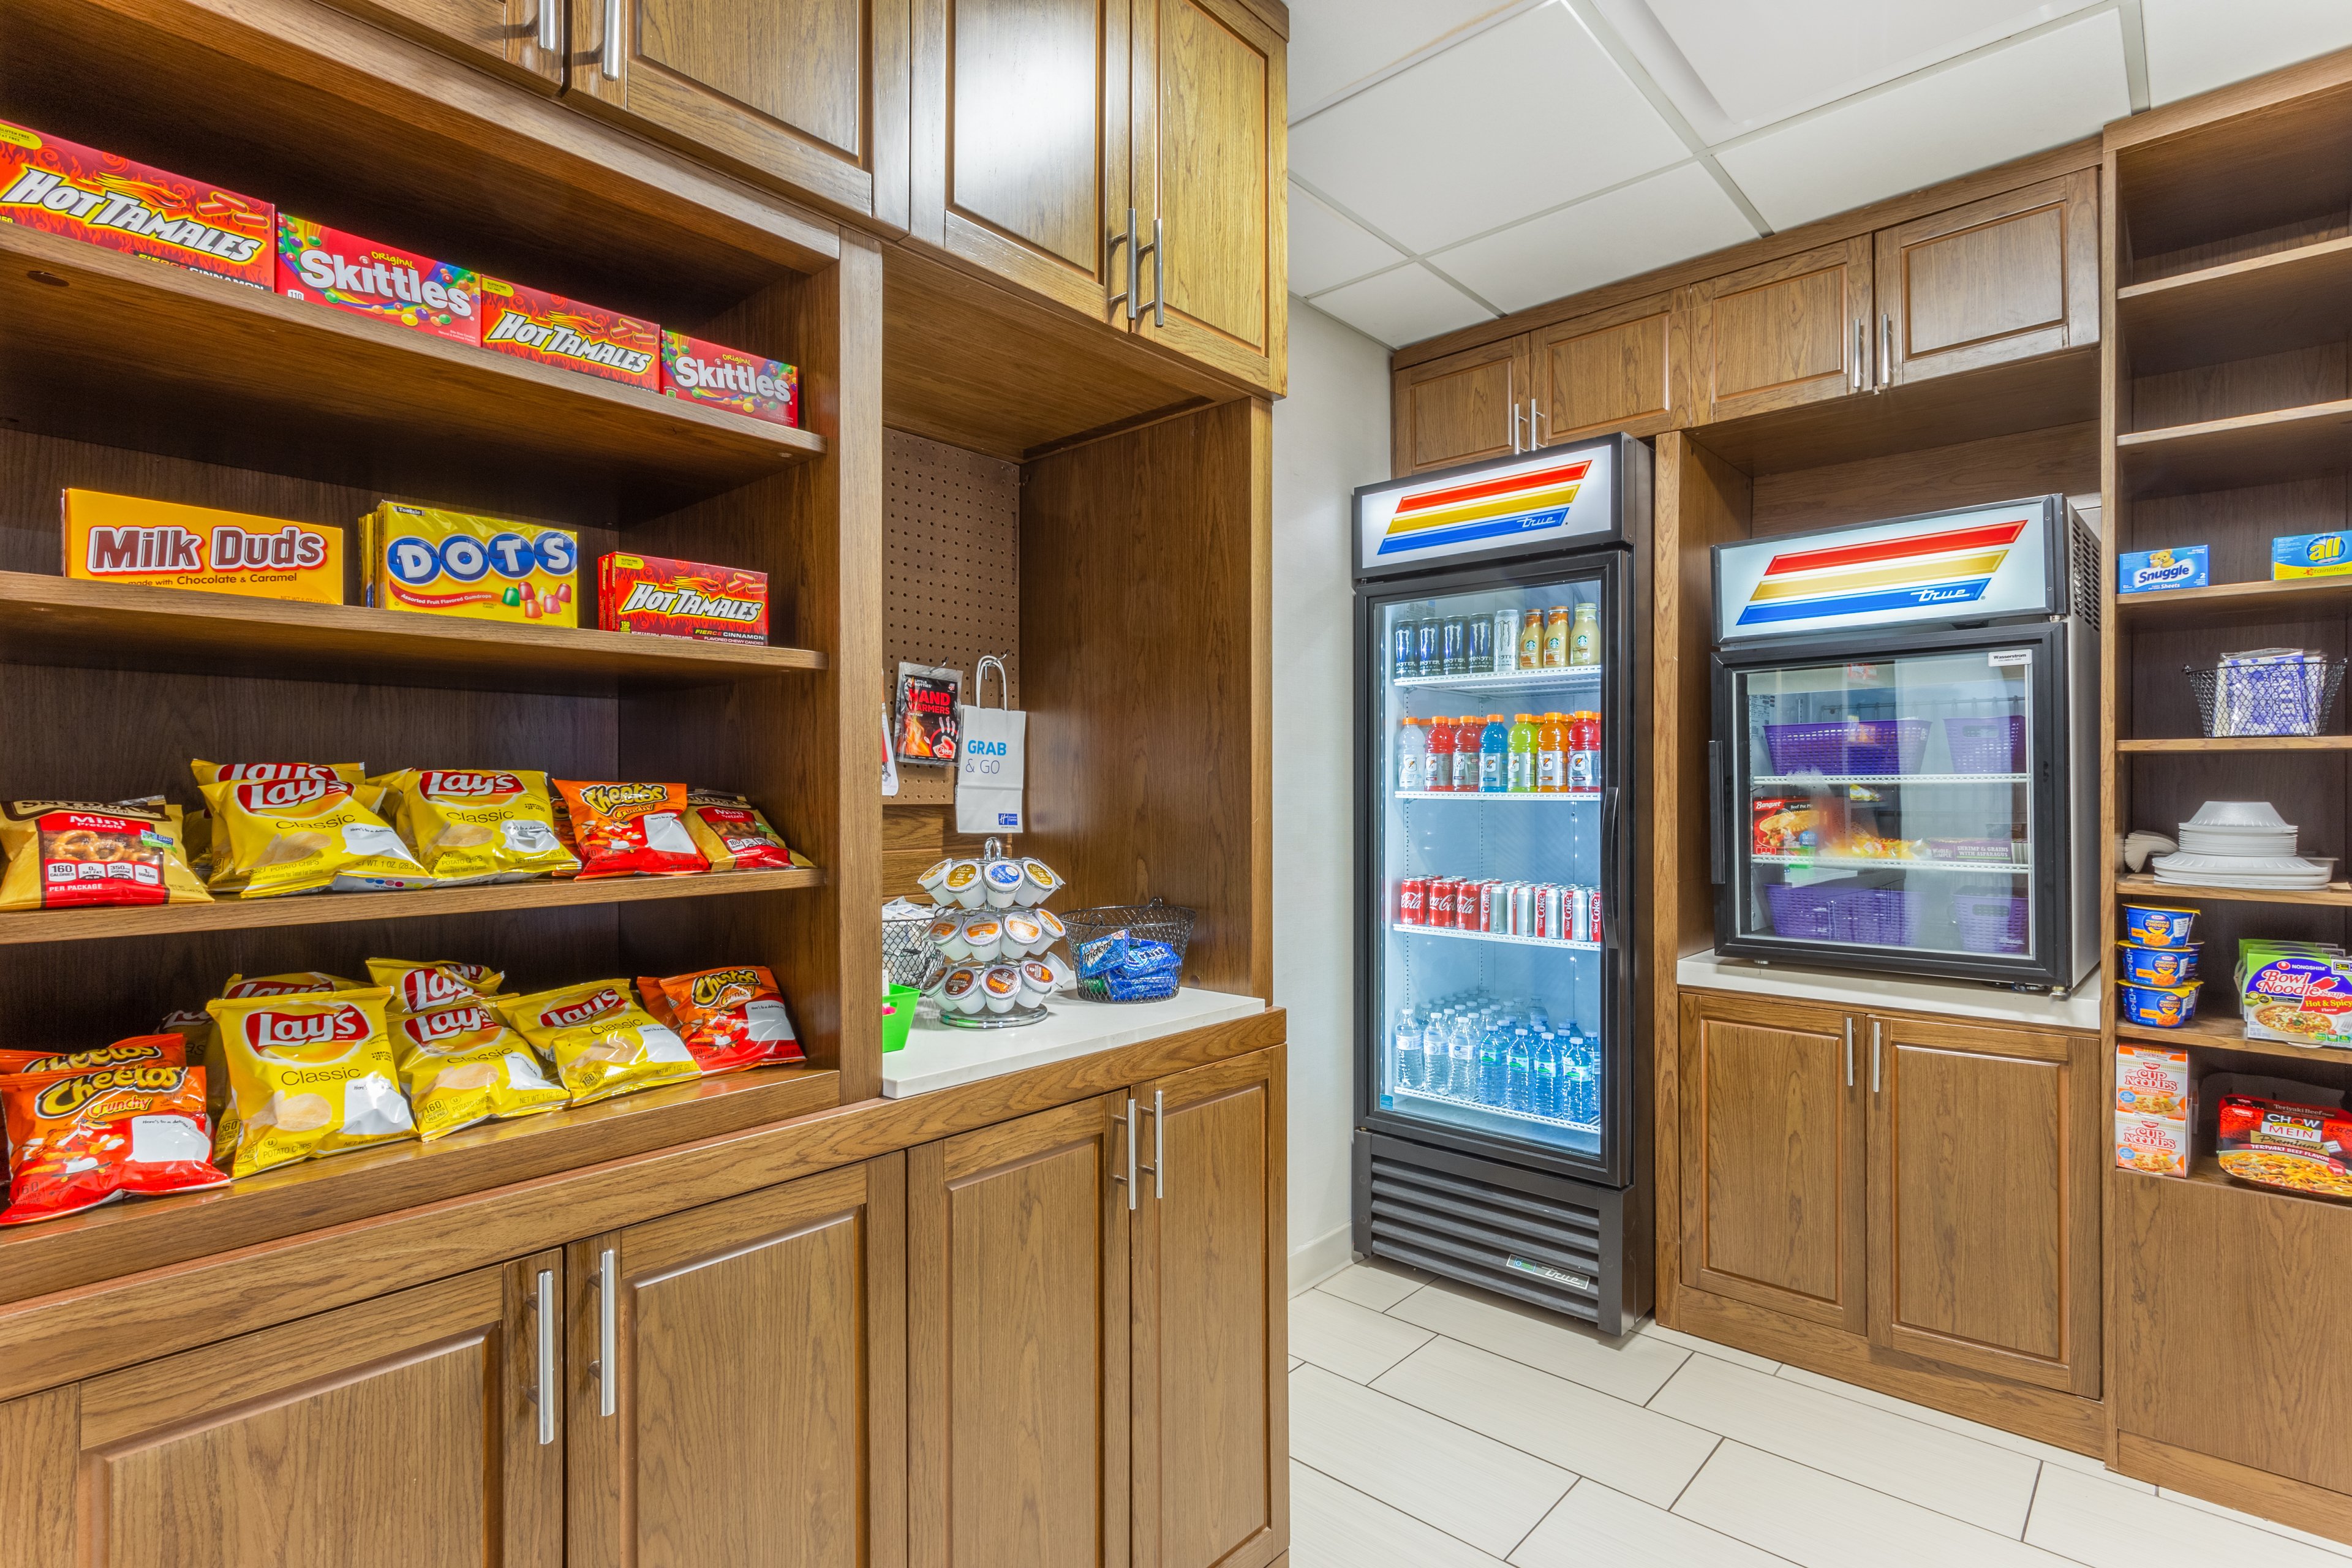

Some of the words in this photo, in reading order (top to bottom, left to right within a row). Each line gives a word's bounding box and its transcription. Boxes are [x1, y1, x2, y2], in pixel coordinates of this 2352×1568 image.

[1, 166, 107, 218] HOT
[88, 190, 263, 262] TAMALES
[300, 249, 472, 317] Skittles
[487, 311, 552, 347] HOT
[543, 325, 653, 372] TAMALES
[675, 356, 791, 402] Skittles
[398, 507, 421, 516] Tootsie
[1517, 516, 1556, 528] true
[89, 527, 203, 573] Milk
[211, 526, 326, 570] Duds
[2309, 537, 2342, 561] all
[397, 537, 570, 579] DOTS
[176, 575, 236, 584] Chocolate
[250, 573, 297, 582] Caramel
[2138, 565, 2190, 584] Snuggle
[401, 593, 426, 605] Assorted
[464, 593, 492, 602] Gumdrops
[621, 582, 679, 612] HOT
[669, 588, 763, 622] TAMALES
[1910, 589, 1974, 602] true
[723, 631, 764, 640] CINNAMON
[909, 688, 951, 706] HAND
[968, 740, 1006, 756] GRAB
[965, 758, 974, 773] &
[980, 760, 1000, 774] GO
[427, 772, 514, 796] Lay's
[250, 780, 348, 809] Lay's
[447, 809, 514, 823] Classic
[613, 804, 654, 820] Crunchy
[714, 808, 744, 817] Mini
[70, 815, 127, 827] Mini
[276, 814, 356, 830] Classic
[270, 862, 297, 872] POTATO
[299, 859, 319, 867] CHIPS
[1537, 894, 1546, 919] Coke
[1564, 896, 1572, 921] Coke
[1084, 940, 1112, 962] Trident
[2262, 970, 2310, 984] Bowl
[2257, 981, 2320, 996] Noodle
[2331, 1000, 2352, 1008] Spicy
[258, 1011, 356, 1047] Lay's
[590, 1018, 644, 1035] Classic
[447, 1046, 513, 1065] Classic
[281, 1067, 361, 1086] Classic
[581, 1073, 595, 1087] 160
[2137, 1069, 2167, 1080] CUP
[38, 1066, 182, 1115] Cheetos
[2124, 1076, 2177, 1091] NOODLES
[87, 1095, 153, 1118] Crunchy
[424, 1100, 442, 1113] 160
[452, 1101, 475, 1112] POTATO
[2274, 1104, 2304, 1113] Teriyaki
[2267, 1113, 2320, 1128] CHOW
[2136, 1127, 2166, 1138] CUP
[2269, 1125, 2313, 1139] MEIN
[2124, 1133, 2176, 1149] NOODLES
[2256, 1134, 2324, 1150] Premium
[263, 1147, 290, 1158] POTATO
[292, 1142, 312, 1153] CHIPS
[2304, 1151, 2330, 1162] FLAVOR
[1542, 1266, 1583, 1286] true
